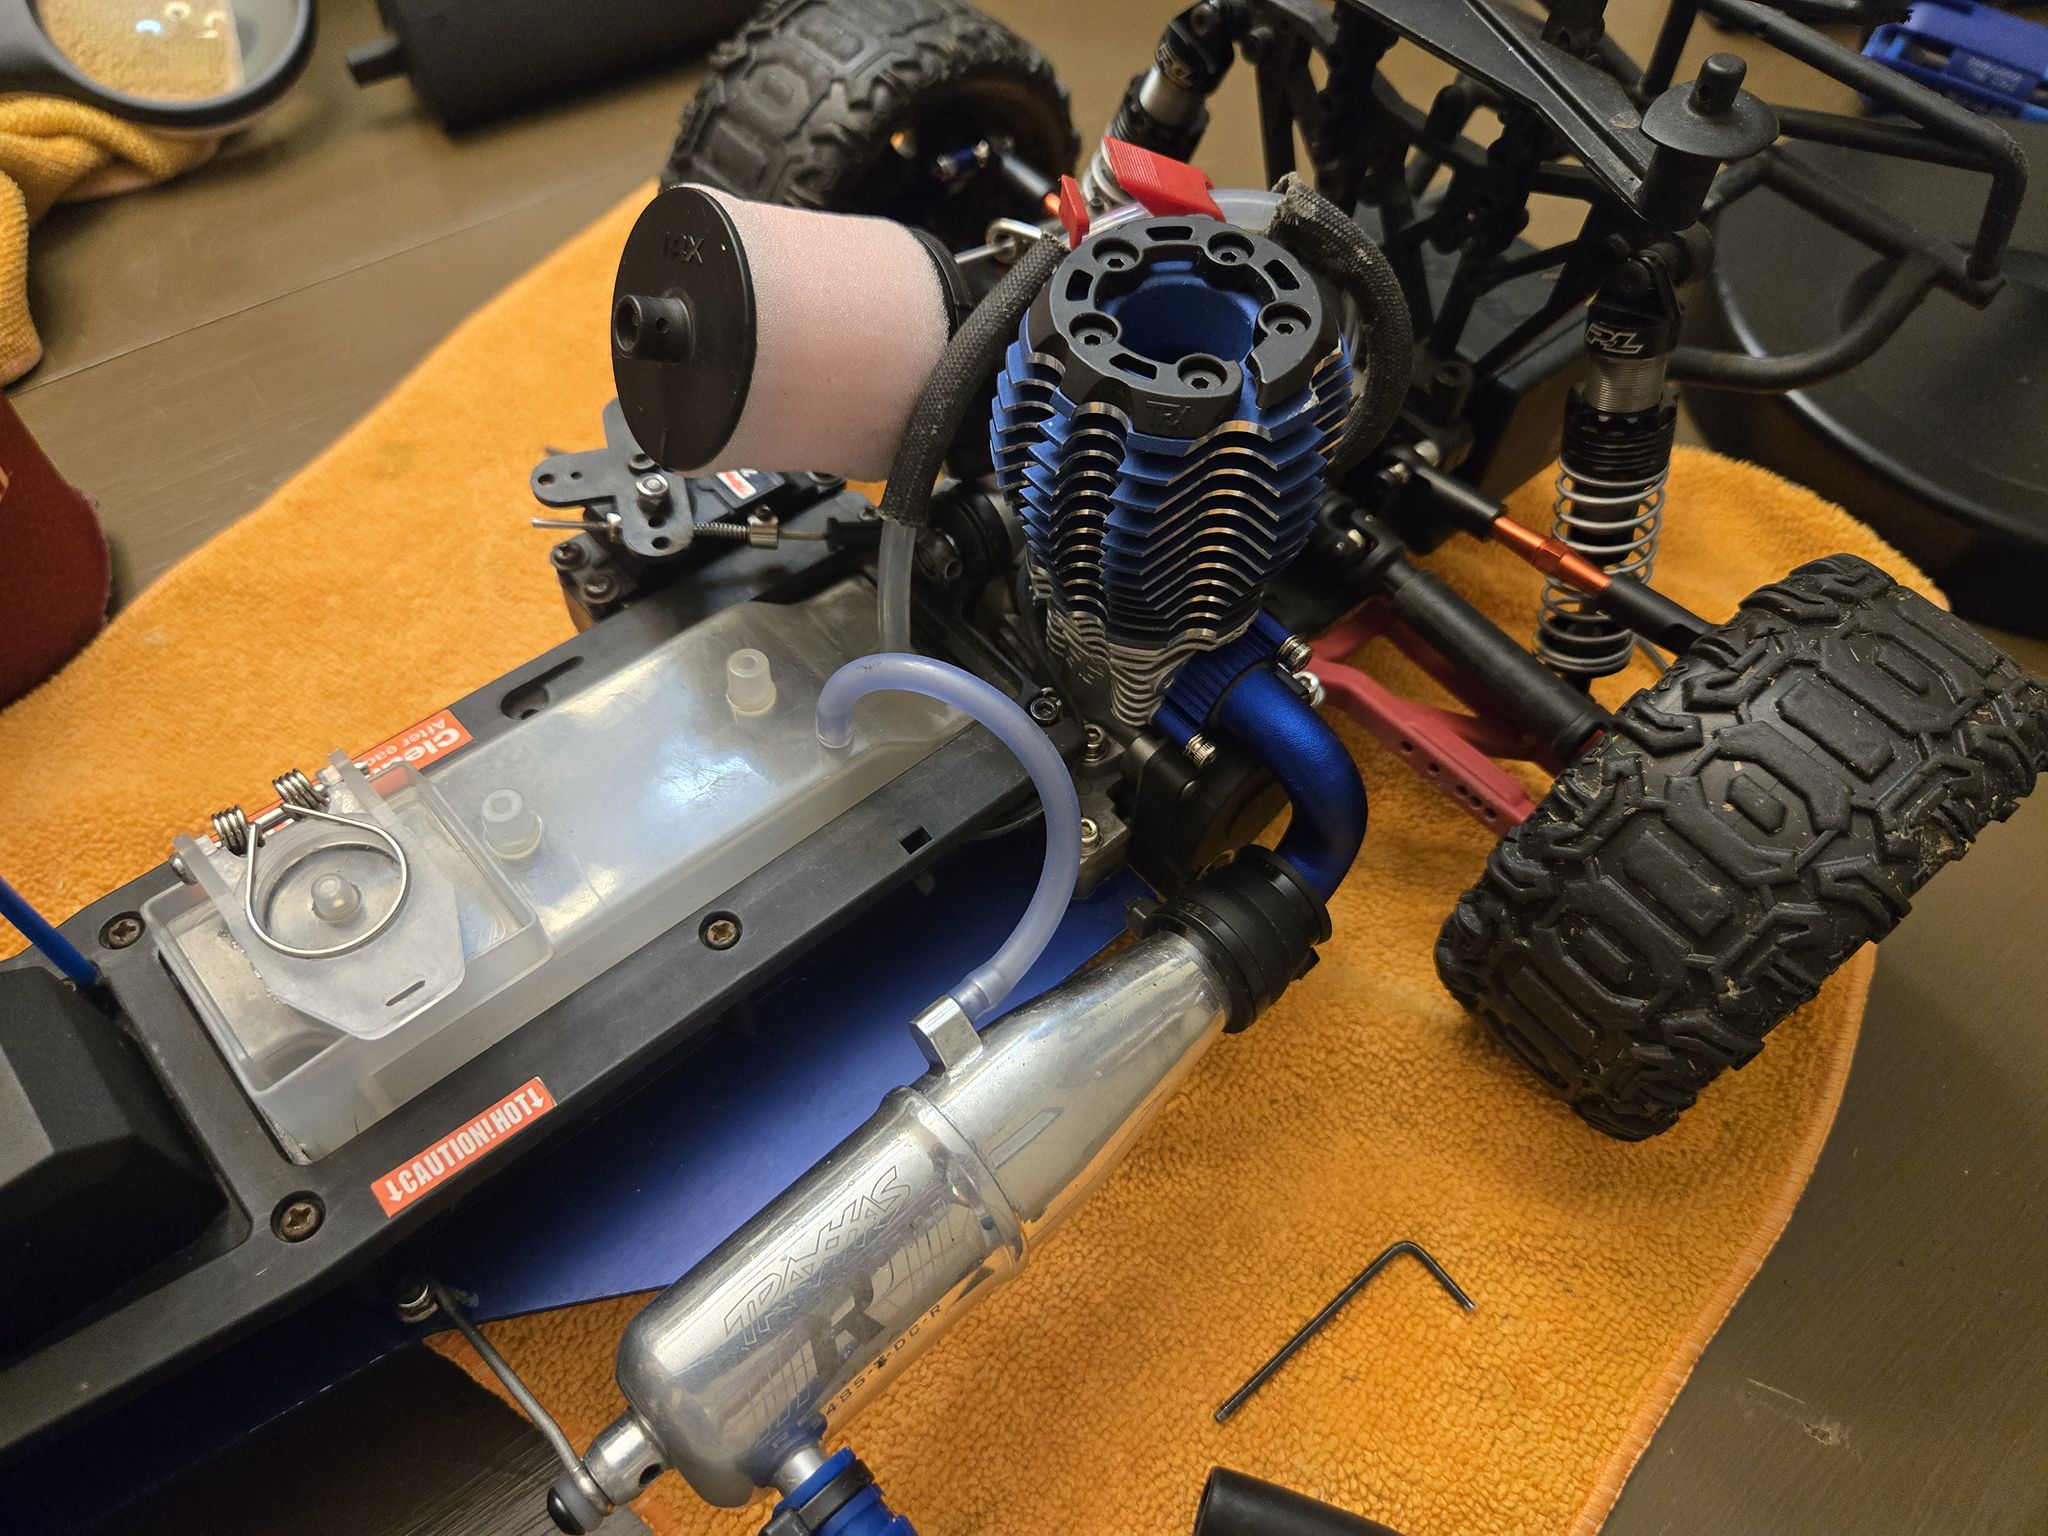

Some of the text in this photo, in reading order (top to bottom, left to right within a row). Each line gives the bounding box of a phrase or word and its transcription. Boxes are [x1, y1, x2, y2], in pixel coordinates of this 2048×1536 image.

[366, 718, 446, 767] After eac
[398, 1092, 533, 1194] CAUTION! HOT
[724, 1165, 911, 1345] TRAXXAS
